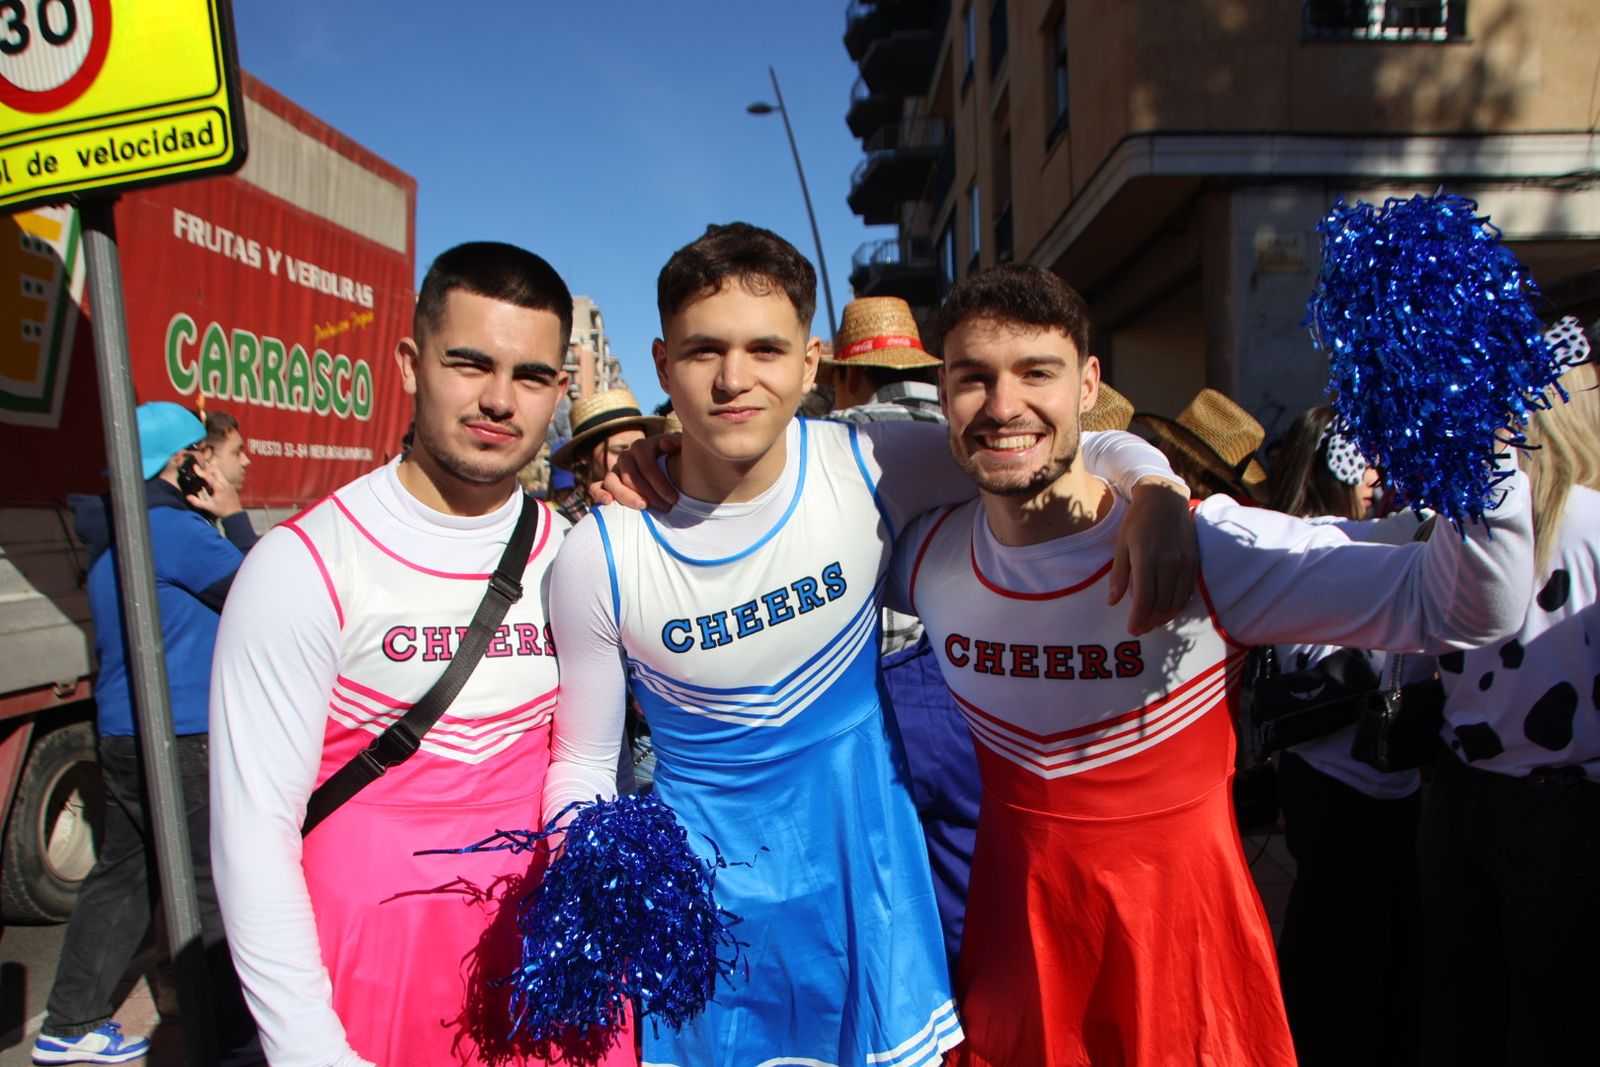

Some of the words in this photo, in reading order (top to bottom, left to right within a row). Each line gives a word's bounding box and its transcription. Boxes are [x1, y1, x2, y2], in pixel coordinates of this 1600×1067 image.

[0, 0, 77, 54] 30
[27, 150, 59, 176] de
[77, 119, 215, 168] velocidad
[173, 207, 262, 270] FRUTAS
[266, 246, 282, 276] Y
[285, 254, 374, 309] VERDURAS
[165, 312, 374, 422] CARRASCO
[661, 561, 847, 653] CHEERS
[945, 633, 1144, 680] CHEERS
